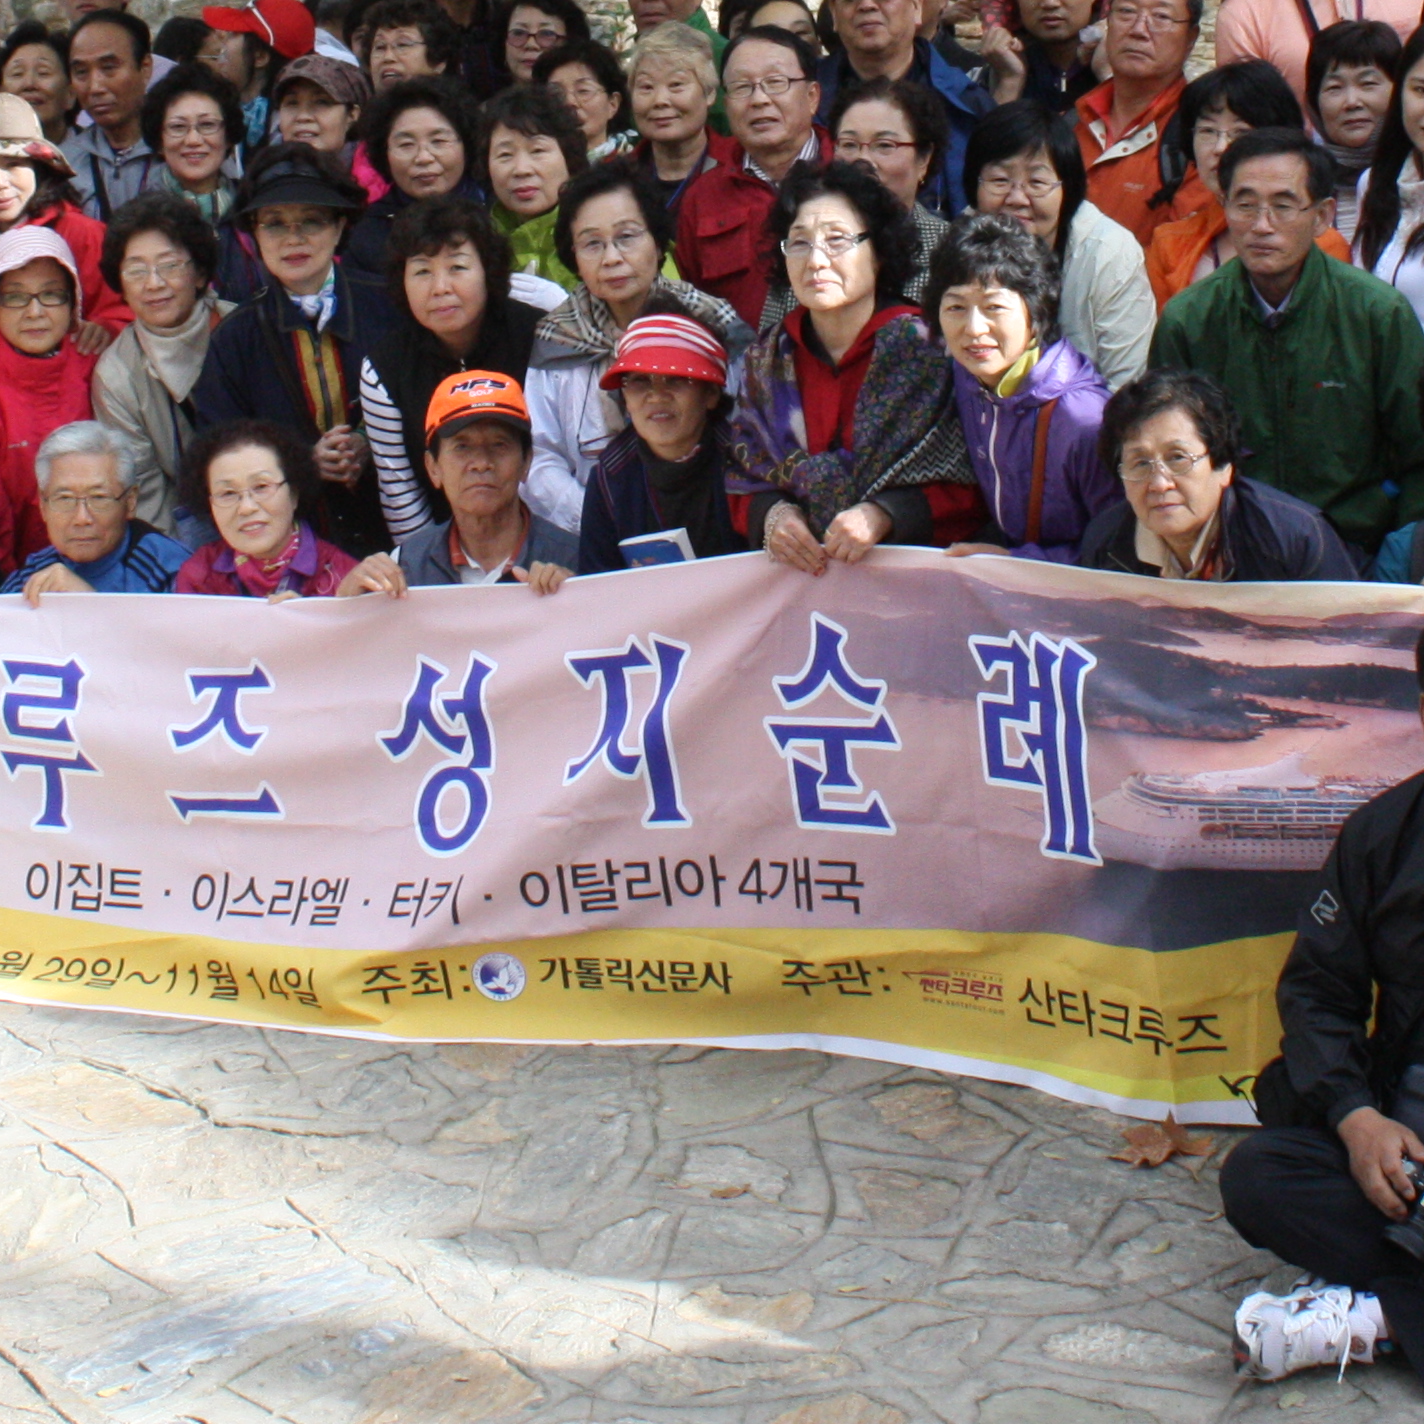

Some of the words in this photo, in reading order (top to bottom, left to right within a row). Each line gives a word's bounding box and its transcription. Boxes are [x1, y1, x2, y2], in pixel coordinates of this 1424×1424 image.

[469, 388, 494, 398] GOLF
[25, 860, 144, 913] 이집트
[191, 871, 349, 926] 이스라엘
[386, 873, 465, 927] 터키
[519, 854, 727, 915] 이탈리아
[738, 857, 865, 915] 4개국
[246, 966, 323, 1009] 14일
[539, 957, 733, 994] 가톨릭신문사
[1018, 978, 1228, 1056] 산타크루즈
